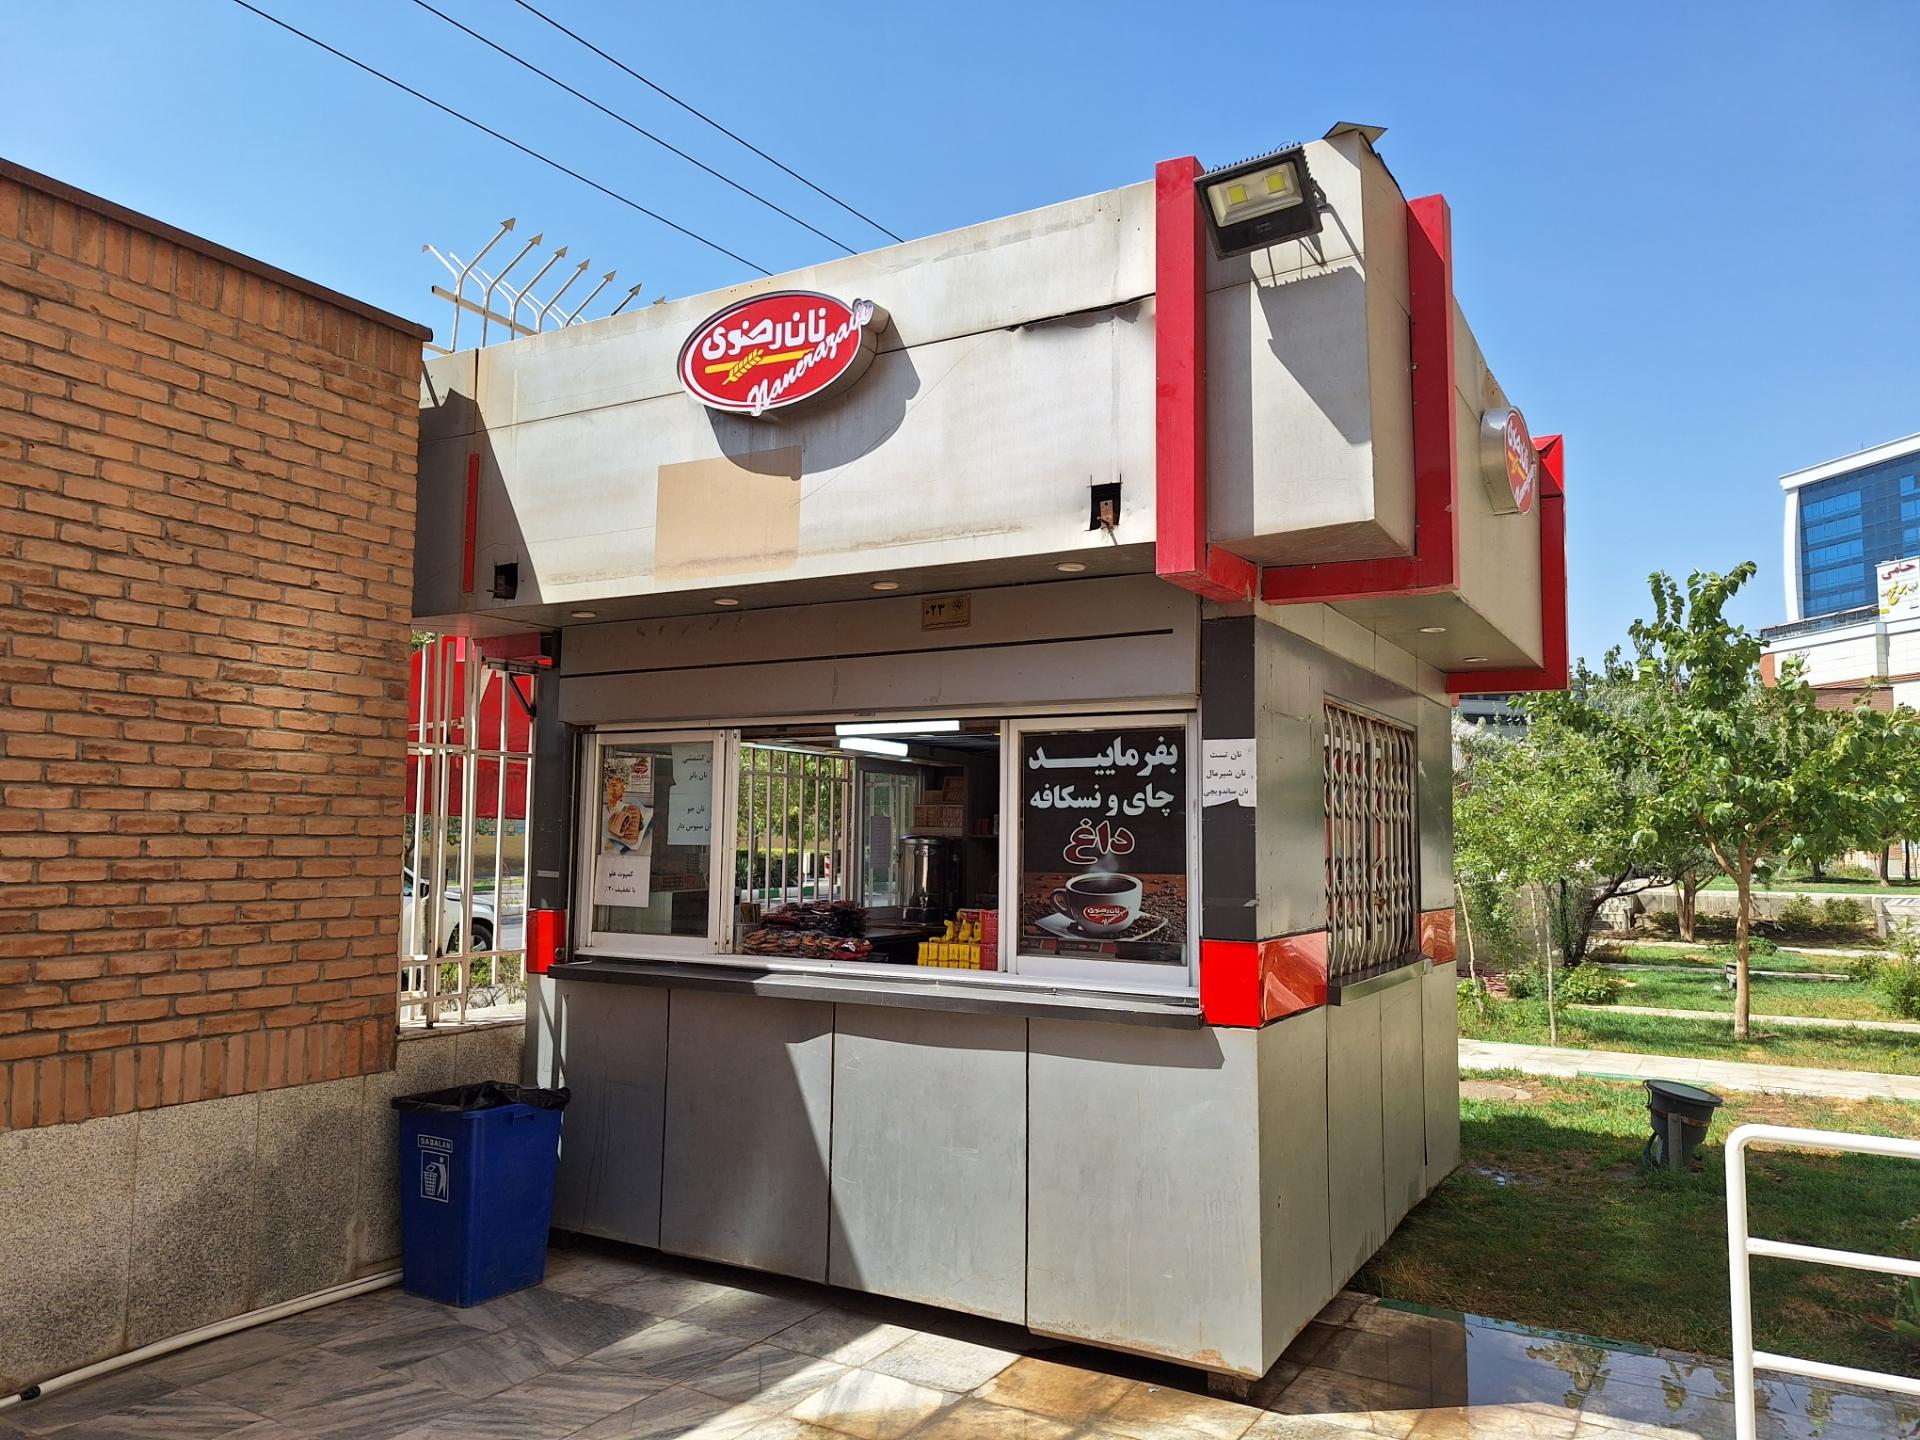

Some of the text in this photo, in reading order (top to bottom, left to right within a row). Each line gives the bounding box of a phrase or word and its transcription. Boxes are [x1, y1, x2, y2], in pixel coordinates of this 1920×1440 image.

[702, 307, 827, 360] نان رضوی
[1230, 750, 1242, 760] نان
[1206, 769, 1247, 779] نان شیرمال
[1030, 783, 1175, 817] چای و نسکافه
[1238, 787, 1249, 796] نان
[1063, 818, 1135, 865] داغ
